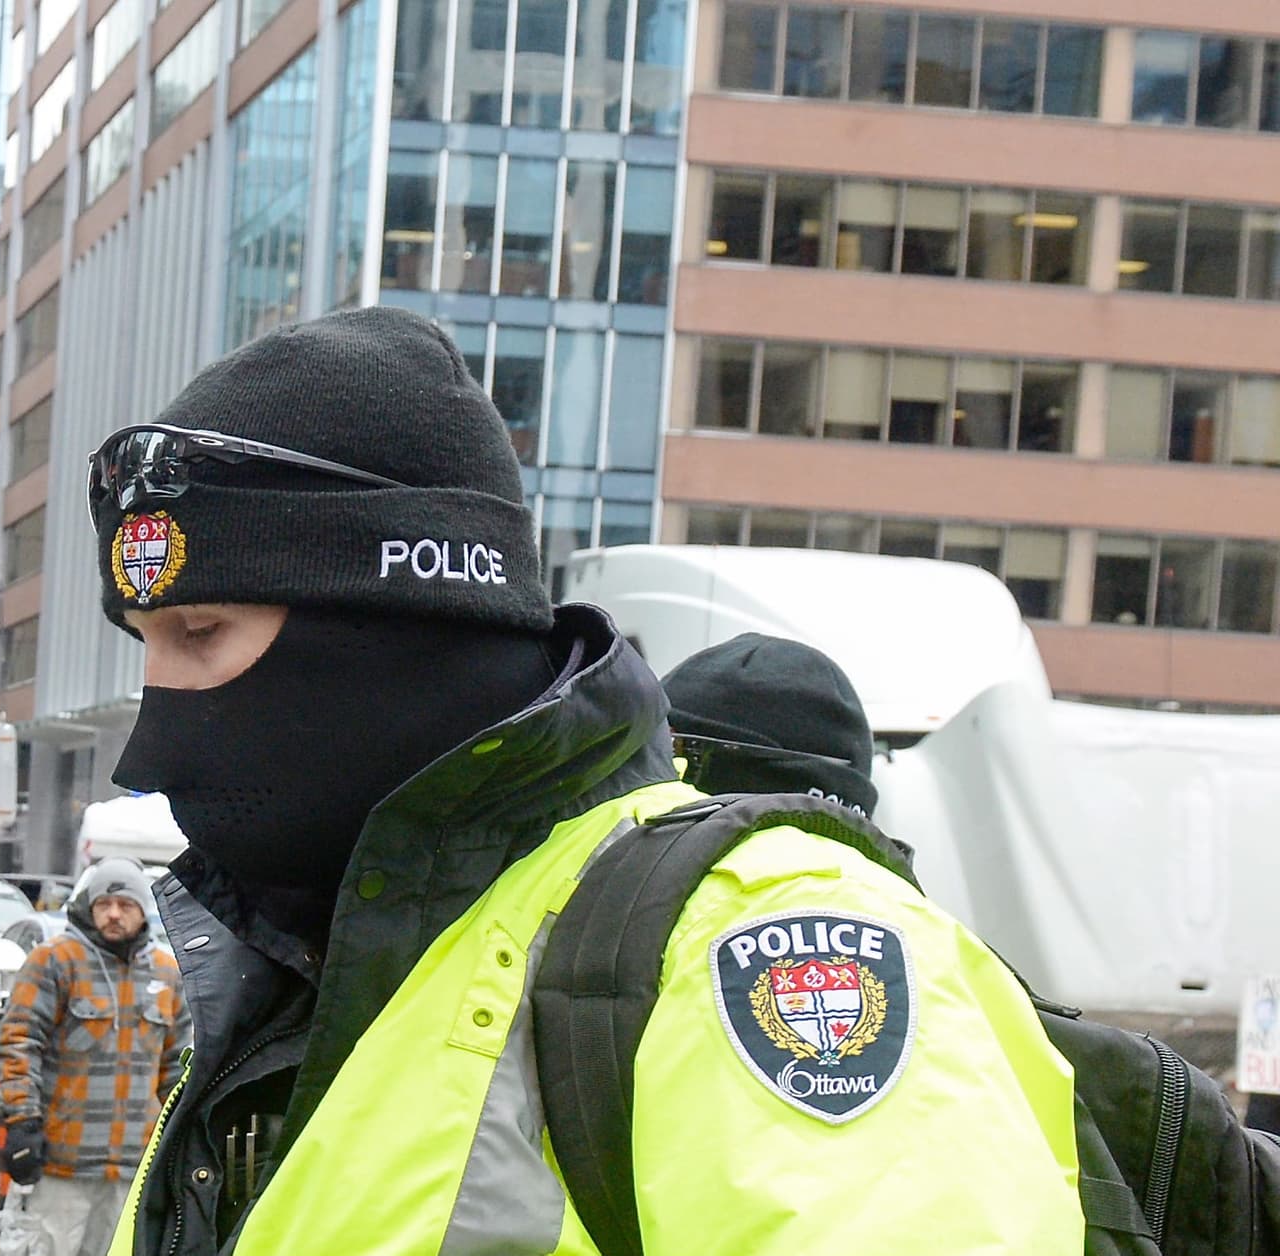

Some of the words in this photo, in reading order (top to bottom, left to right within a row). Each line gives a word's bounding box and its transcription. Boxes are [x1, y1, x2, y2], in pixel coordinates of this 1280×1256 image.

[379, 539, 507, 585] POLICE
[728, 921, 886, 970] POLICE
[780, 1062, 878, 1098] Ottawa
